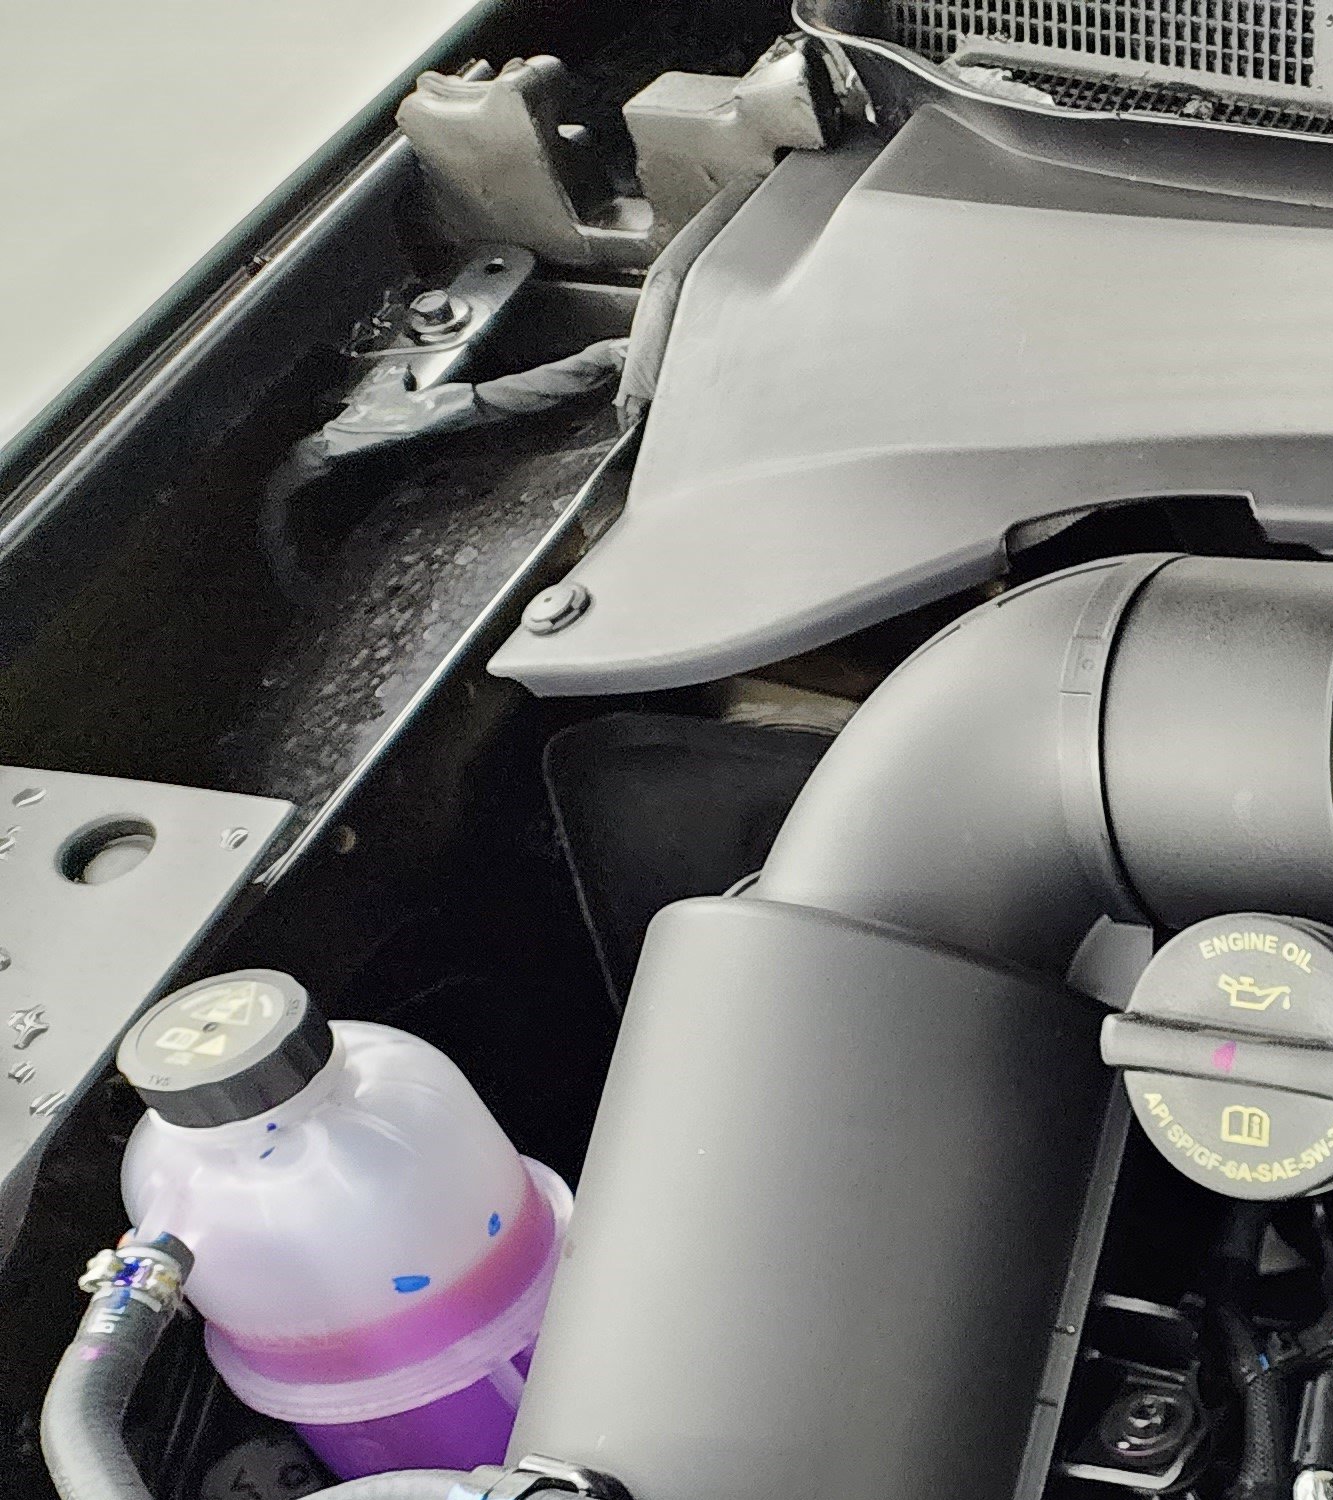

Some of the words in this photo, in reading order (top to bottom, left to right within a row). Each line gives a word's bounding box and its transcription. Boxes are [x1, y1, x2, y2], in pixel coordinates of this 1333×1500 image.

[1200, 932, 1279, 959] ENGINE
[1281, 941, 1315, 975] OIL
[1143, 1092, 1171, 1127] API
